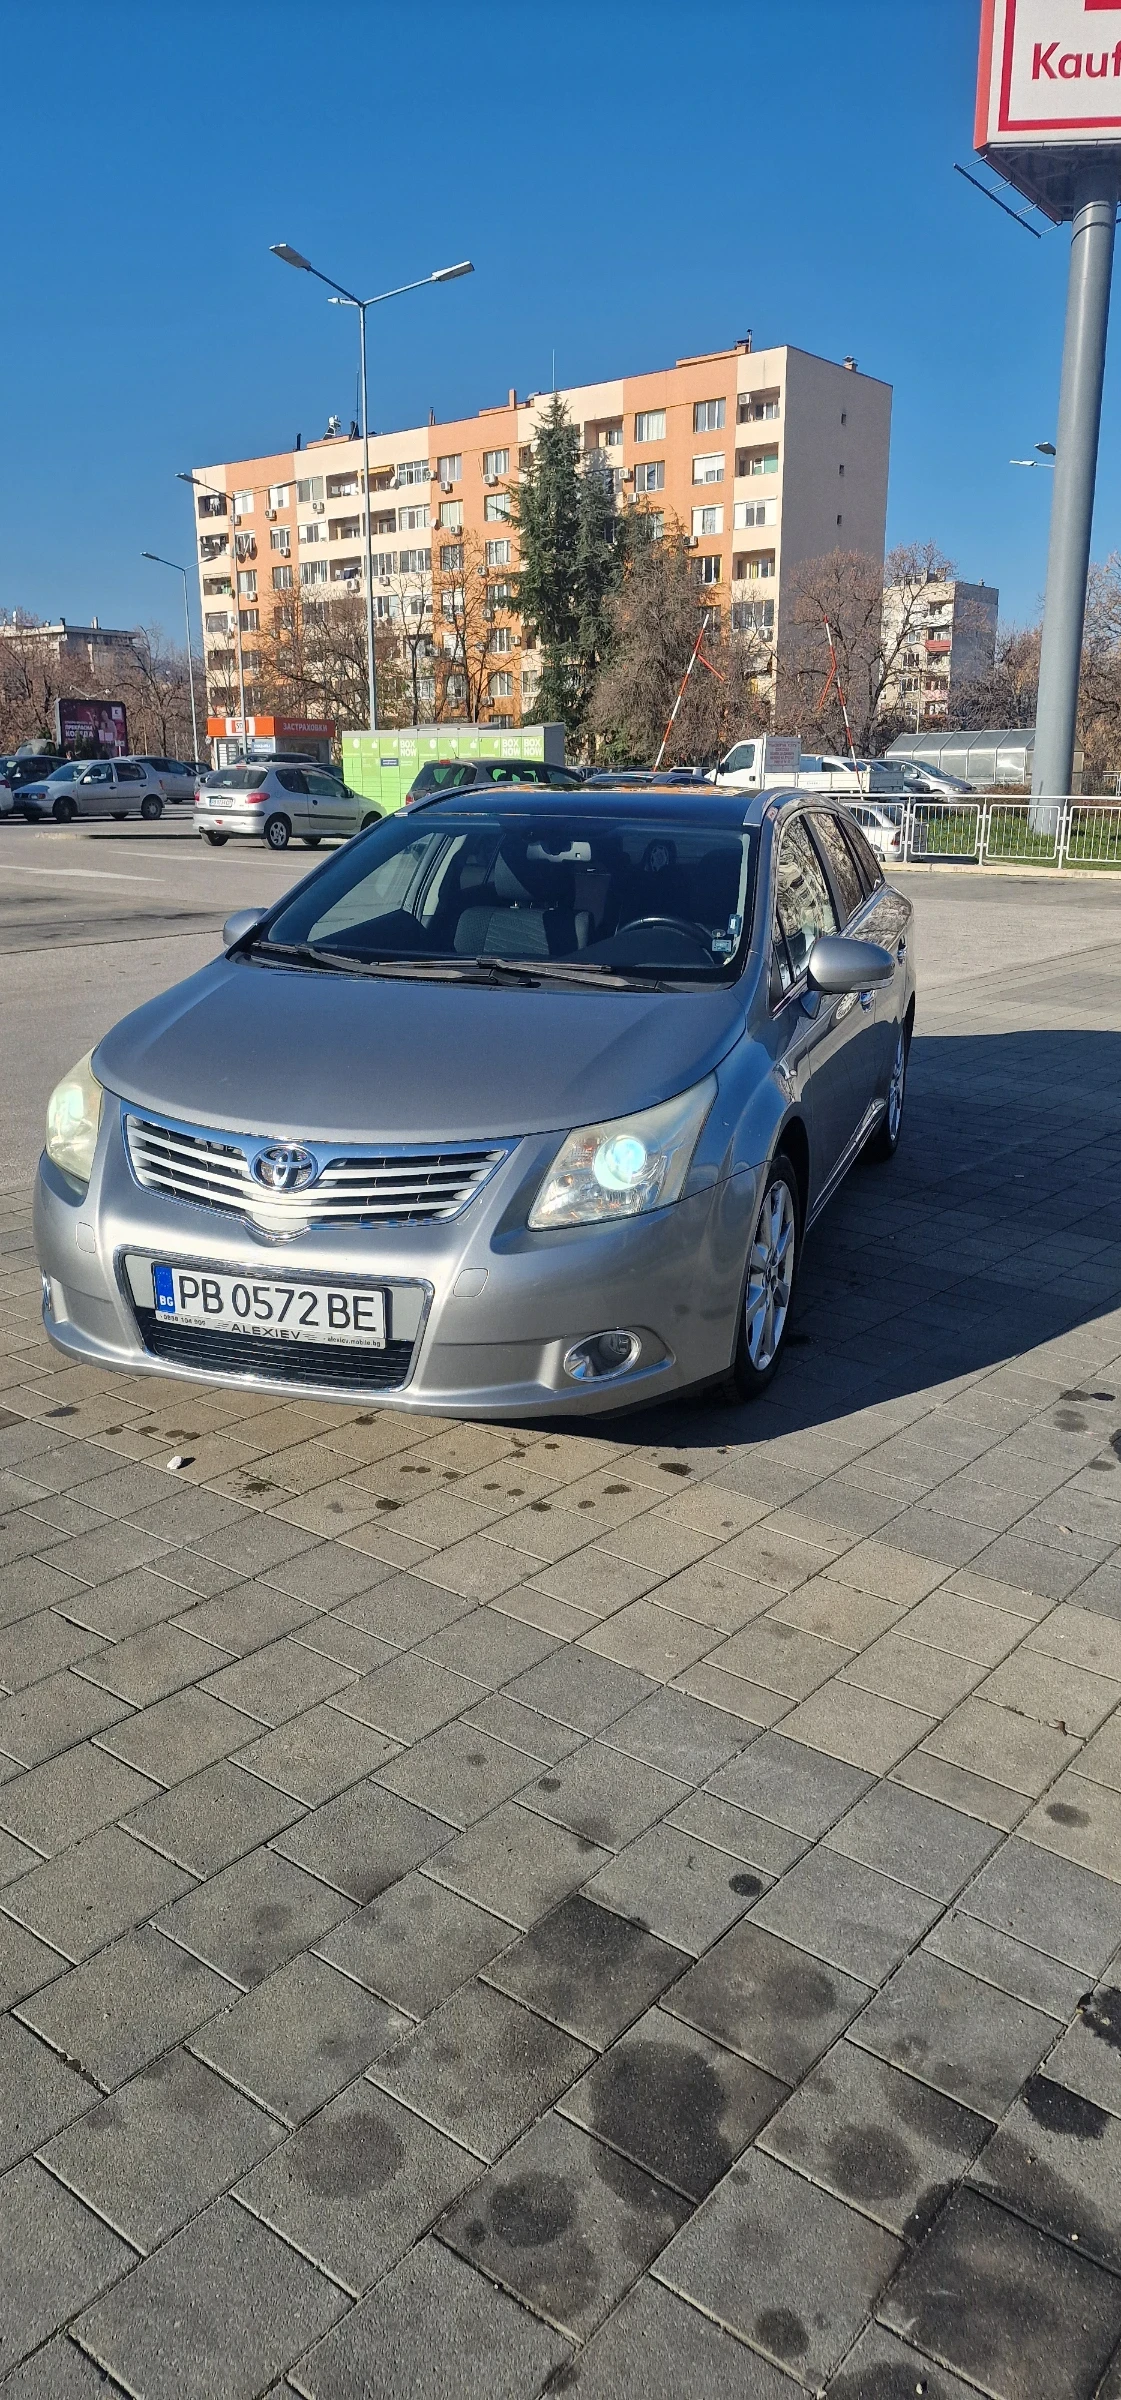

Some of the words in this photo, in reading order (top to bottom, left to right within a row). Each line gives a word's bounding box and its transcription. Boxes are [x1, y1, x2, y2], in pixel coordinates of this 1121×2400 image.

[282, 722, 328, 732] ЗАСТРАХОВКИ
[400, 740, 416, 748] BOX
[502, 739, 519, 747] BOX
[523, 738, 541, 747] BOX
[400, 748, 417, 757] NOW
[502, 747, 521, 757] NOW
[523, 747, 543, 756] NOW
[159, 1295, 174, 1307] BG
[179, 1275, 224, 1314] PB
[231, 1283, 319, 1326] 0572
[327, 1293, 377, 1332] BE
[231, 1323, 301, 1340] ALEXIEV
